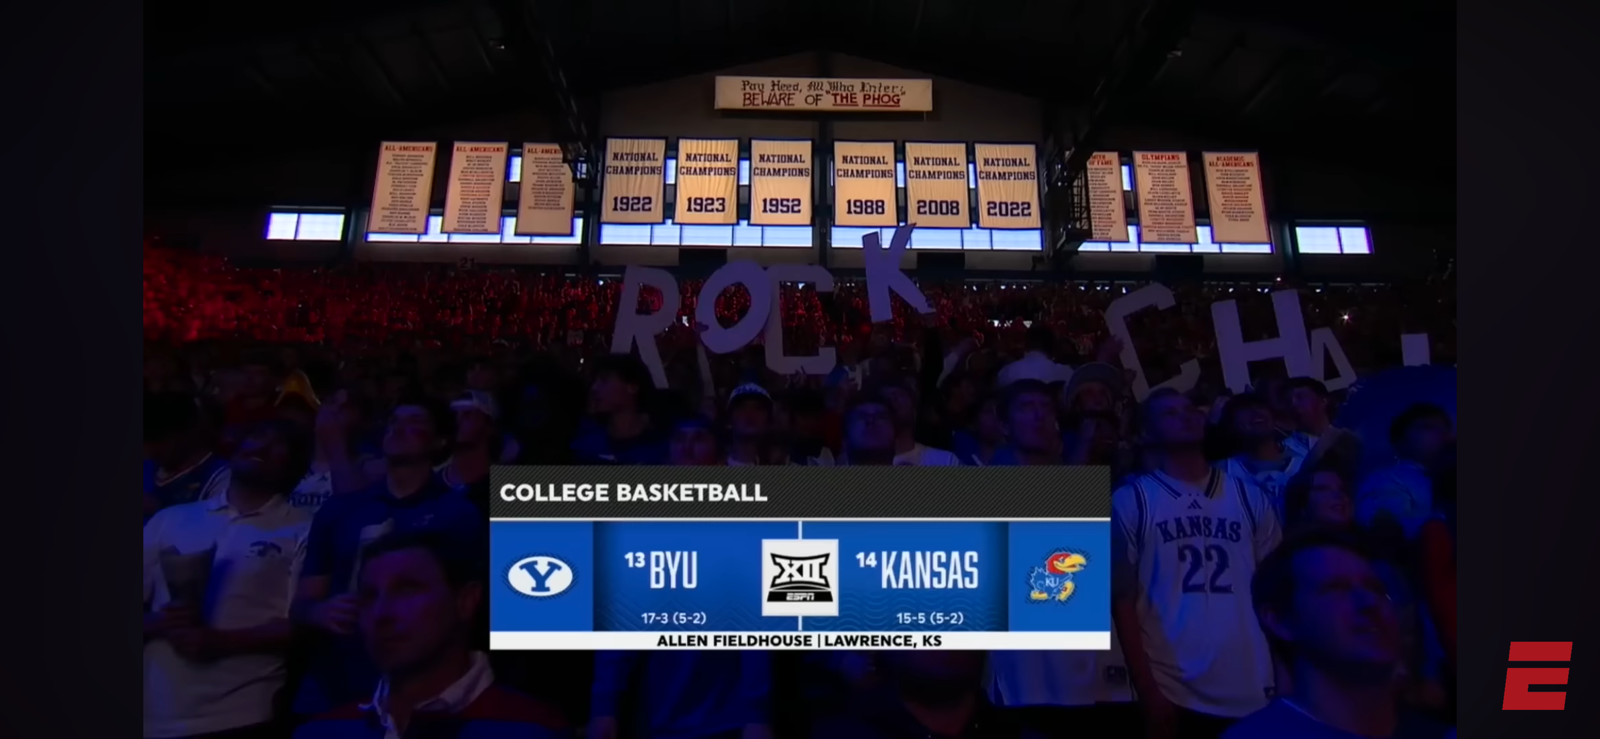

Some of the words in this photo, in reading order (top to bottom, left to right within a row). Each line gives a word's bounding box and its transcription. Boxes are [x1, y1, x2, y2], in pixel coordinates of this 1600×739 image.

[742, 80, 764, 92] Pay
[770, 80, 802, 93] Heed,
[807, 81, 824, 92] All
[827, 81, 854, 92] Who
[742, 92, 795, 106] BEWARE
[804, 94, 823, 106] OF
[612, 152, 658, 162] NATIONAL
[686, 153, 732, 163] NATIONAL
[759, 154, 805, 164] NATIONAL
[842, 155, 888, 165] NATIONAL
[914, 156, 960, 166] NATIONAL
[984, 158, 1030, 167] NATIONAL
[606, 166, 662, 176] CHAMPIONS
[680, 166, 736, 176] CHAMPIONS
[754, 167, 810, 177] CHAMPIONS
[836, 168, 893, 178] CHAMPIONS
[908, 170, 965, 180] CHAMPIONS
[978, 170, 1036, 181] CHAMPIONS
[612, 196, 652, 212] 1922
[686, 197, 726, 212] 1923
[762, 198, 802, 214] 1952
[846, 198, 885, 215] 1988
[917, 200, 960, 216] 2008
[986, 201, 1032, 217] 2022
[1156, 515, 1241, 544] KANSAS
[1178, 544, 1234, 594] 22
